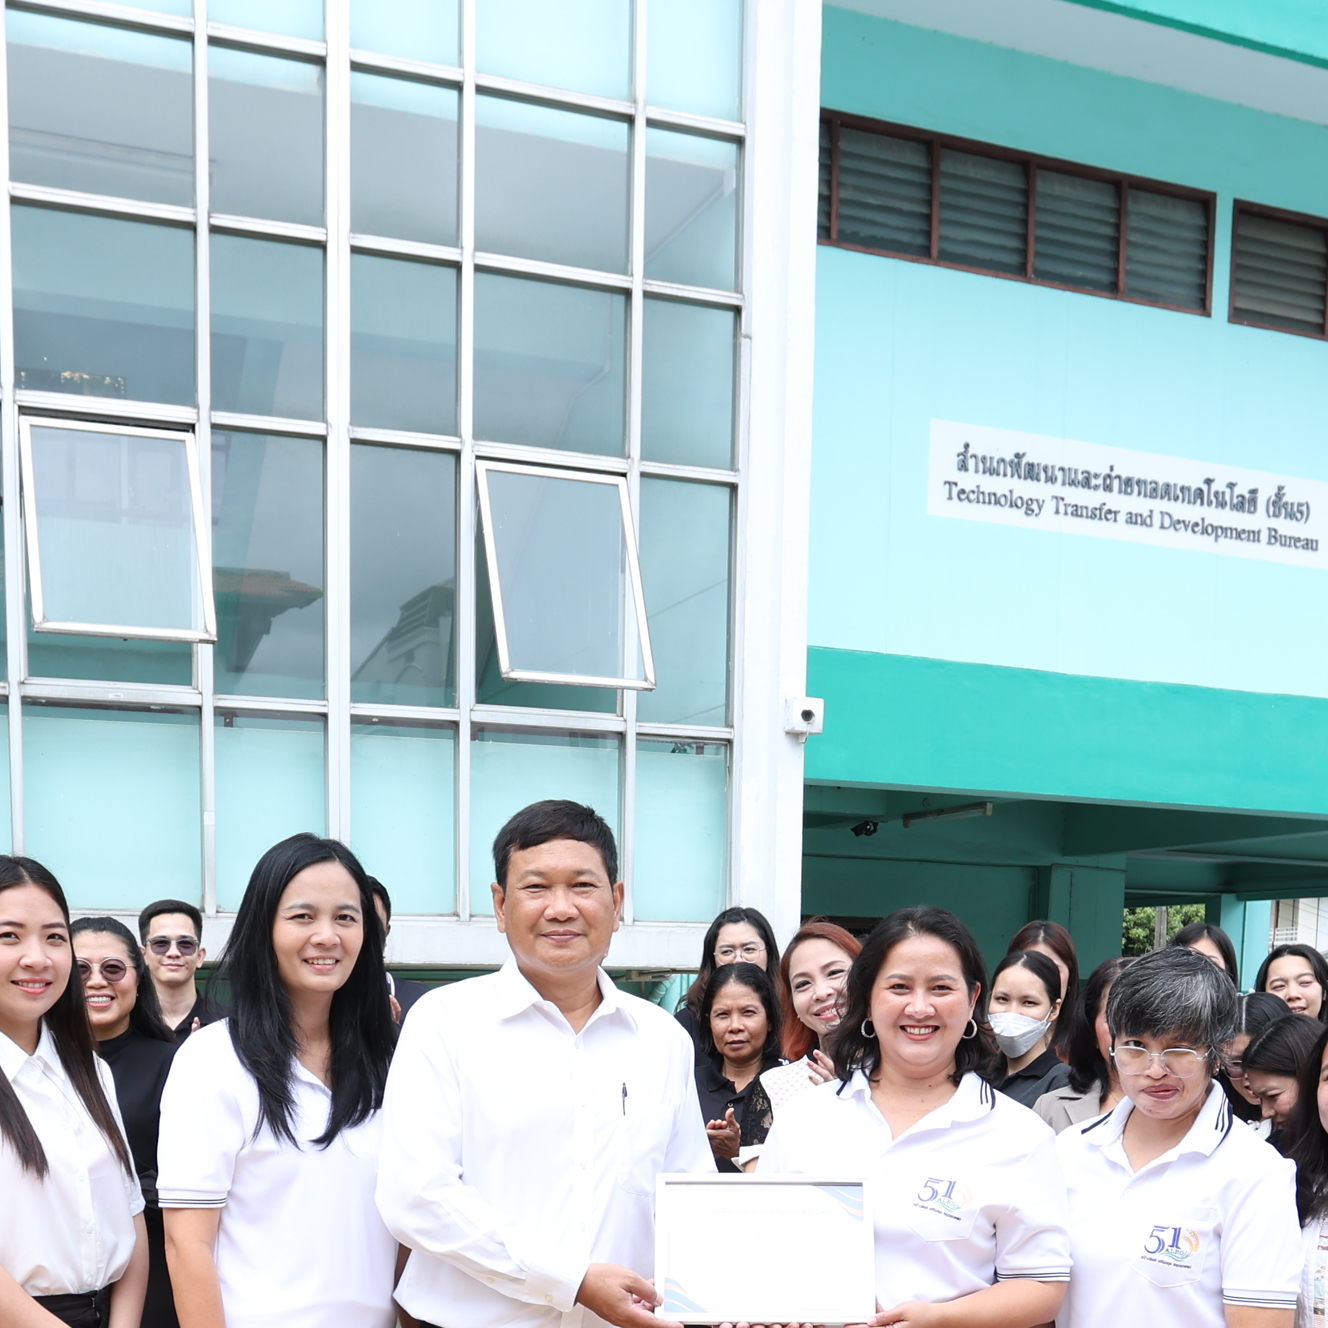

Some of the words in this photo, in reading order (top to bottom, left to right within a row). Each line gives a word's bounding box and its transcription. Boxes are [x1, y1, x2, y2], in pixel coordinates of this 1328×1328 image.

[943, 480, 1045, 516] Technology
[1051, 494, 1121, 523] Transfer
[1125, 508, 1154, 528] and
[1159, 511, 1262, 543] Development
[1267, 527, 1319, 552] Bureau
[917, 1176, 957, 1202] 51
[1143, 1225, 1183, 1254] 51
